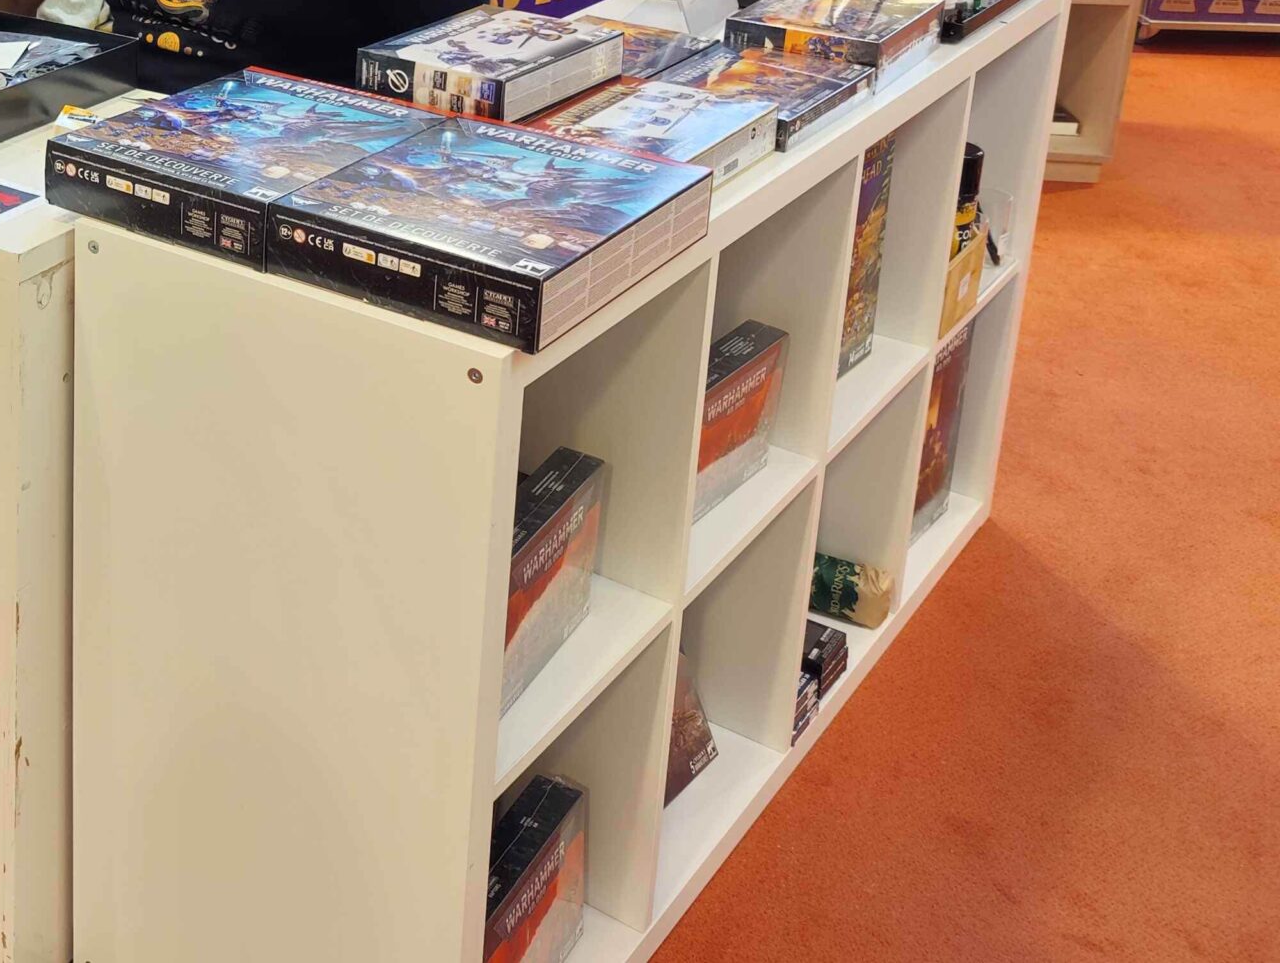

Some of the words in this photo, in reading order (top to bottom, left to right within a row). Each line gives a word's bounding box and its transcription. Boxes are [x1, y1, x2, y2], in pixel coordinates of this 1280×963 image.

[255, 76, 409, 117] WARHAMMER
[96, 142, 123, 153] SET
[124, 149, 145, 159] DE
[146, 153, 242, 186] DÉCOUVERTE
[476, 125, 658, 173] WARHAMMER
[328, 205, 360, 219] SET
[363, 213, 386, 225] DE
[389, 219, 503, 257] DÉCOUVERTE
[707, 367, 767, 421] WARHAMMER
[523, 505, 584, 585] WARHAMMER
[506, 841, 566, 933] WARHAMMER
